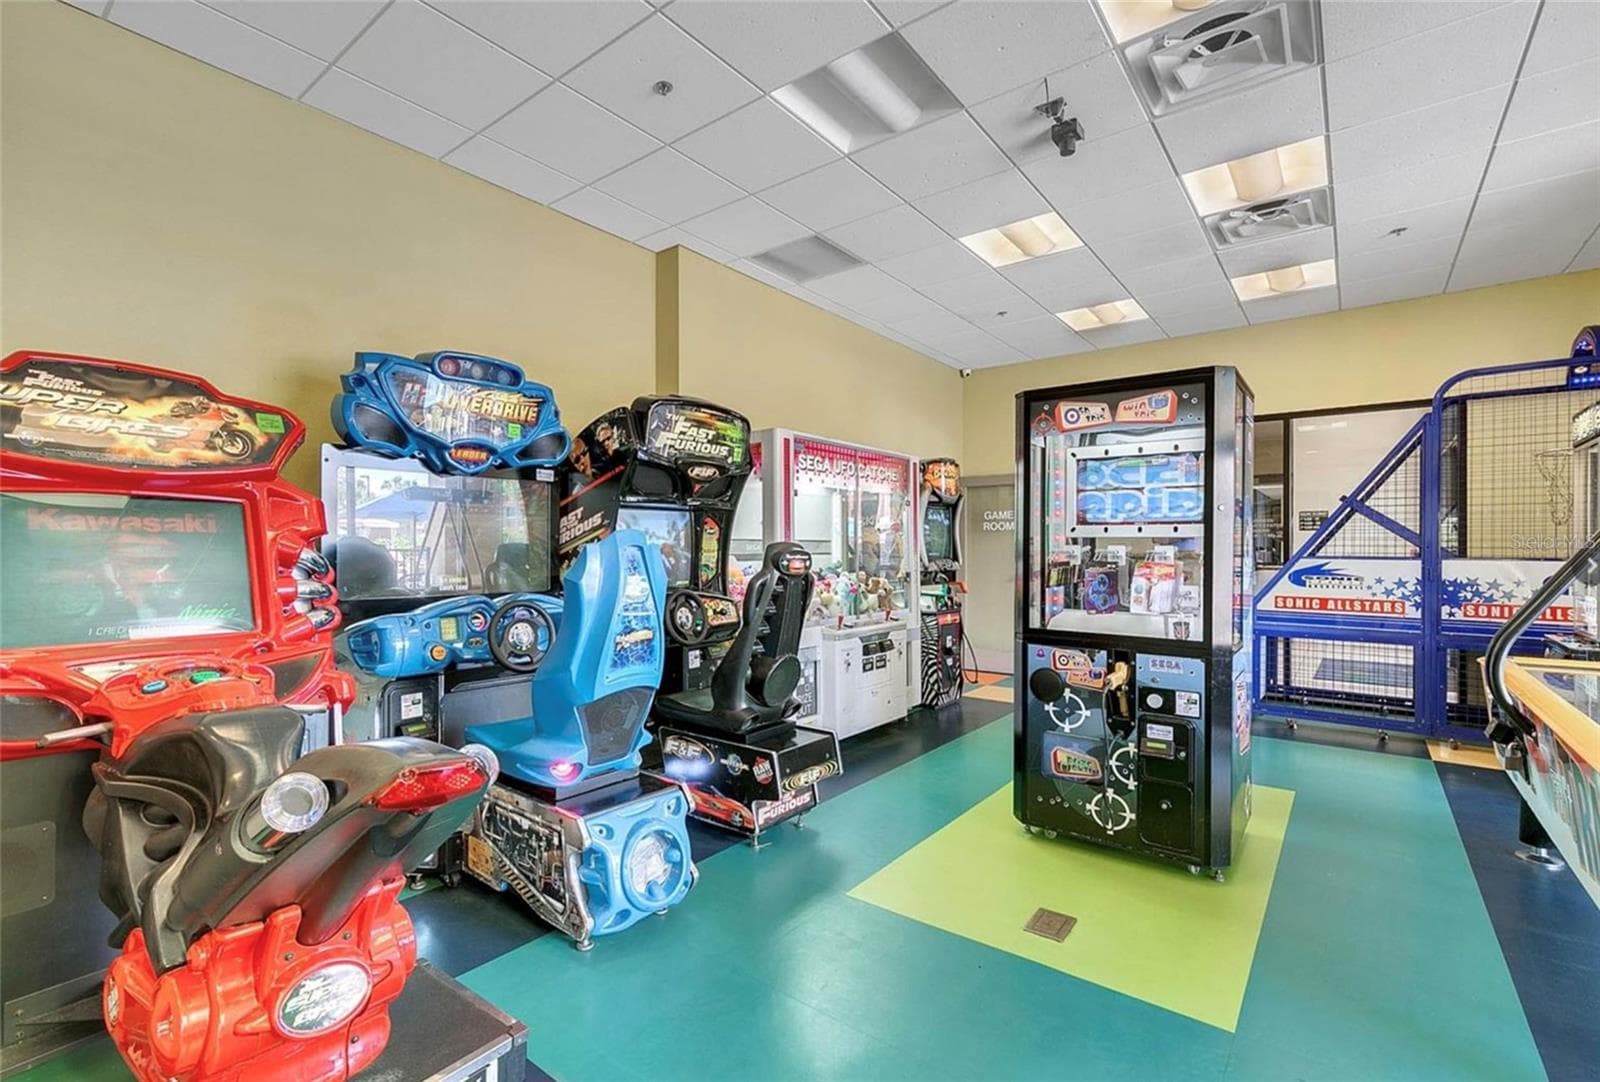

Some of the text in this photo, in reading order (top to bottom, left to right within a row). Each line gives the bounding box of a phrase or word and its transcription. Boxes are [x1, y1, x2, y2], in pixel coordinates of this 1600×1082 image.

[0, 383, 128, 415] UPER
[674, 415, 716, 440] FAST
[656, 431, 730, 457] FURIOUS
[799, 454, 832, 473] SEGA
[833, 459, 856, 477] UFO
[27, 508, 218, 534] Kawasaki
[560, 506, 584, 528] AST
[983, 522, 1015, 531] ROOM
[984, 511, 1015, 520] GAME
[1276, 596, 1403, 614] SONIC ALLSTARS
[1466, 604, 1520, 618] SONI
[664, 740, 703, 757] F&F
[758, 791, 813, 825] FURIOUS
